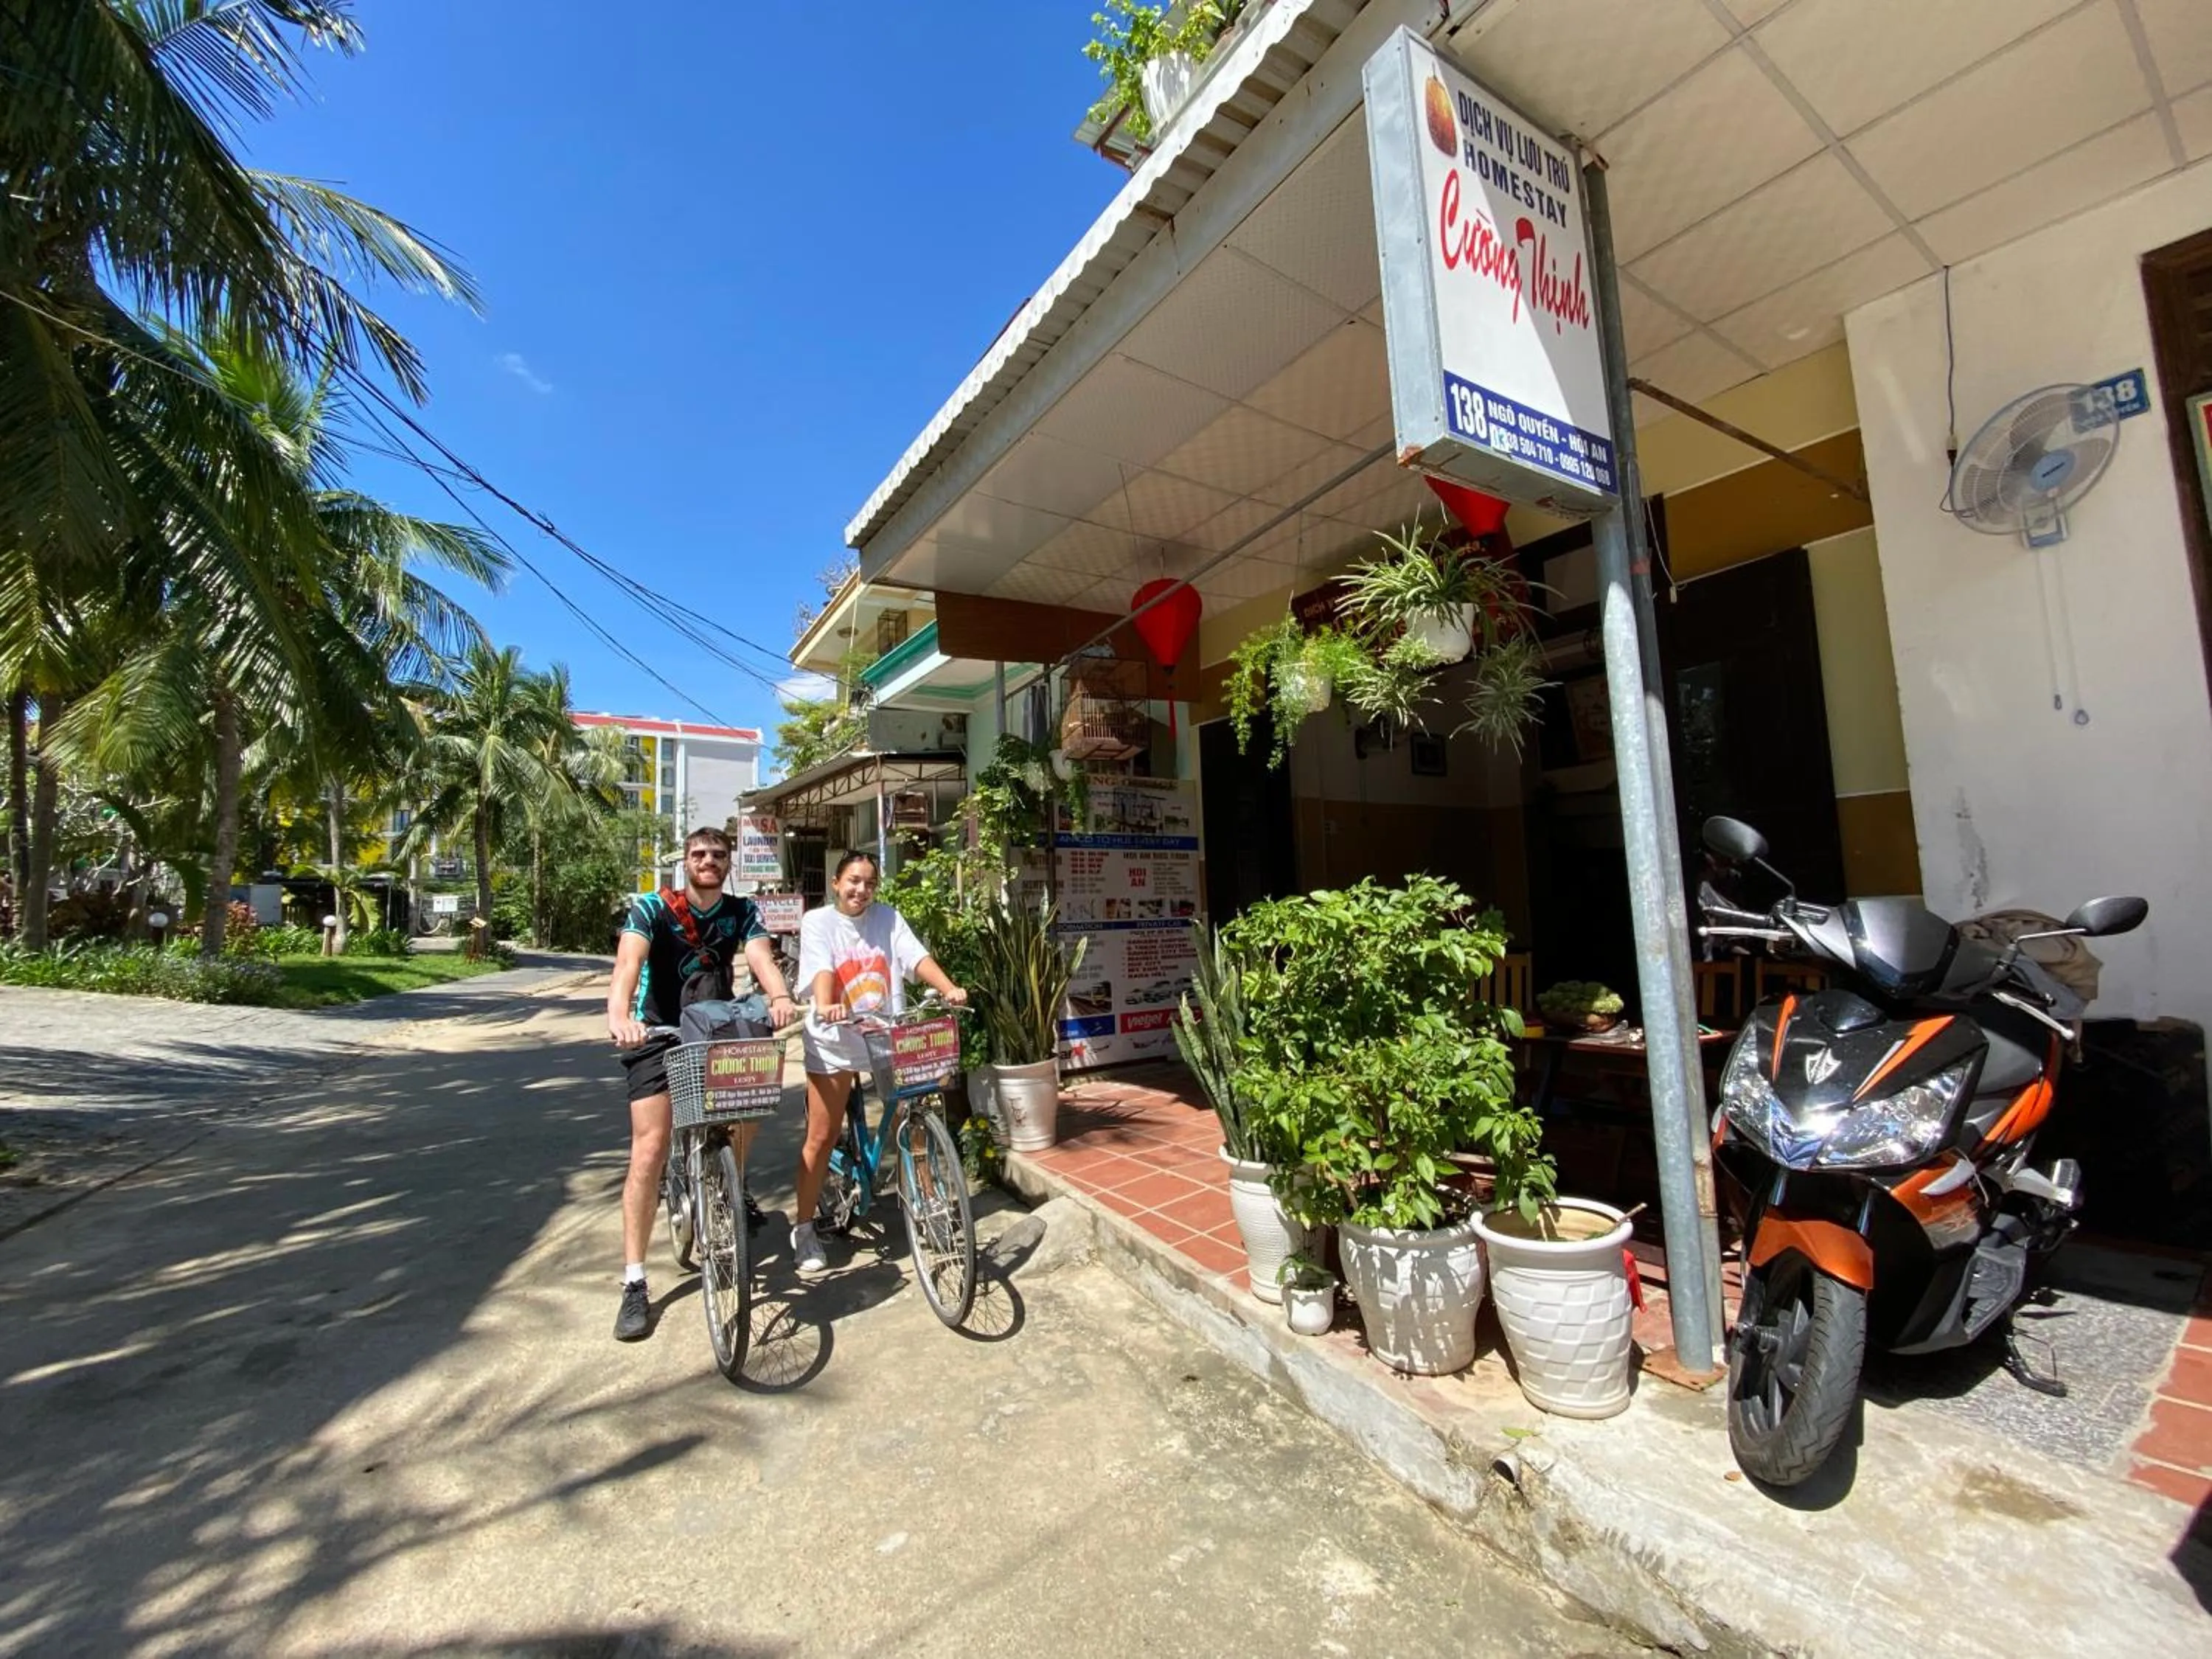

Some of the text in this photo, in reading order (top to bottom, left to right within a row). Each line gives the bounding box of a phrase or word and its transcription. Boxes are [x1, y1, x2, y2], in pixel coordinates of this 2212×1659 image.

[1458, 90, 1494, 145] DỊCH
[1495, 116, 1514, 163] VỤ
[1463, 139, 1567, 229] HOMESTAY
[1440, 168, 1590, 335] Cường Thịnh
[1451, 383, 1487, 439] 138
[2086, 379, 2138, 413] 138
[1487, 399, 1516, 427] NGÔ
[1591, 443, 1607, 464] AN
[1130, 877, 1146, 887] AN
[724, 1045, 766, 1055] HOMESTAY
